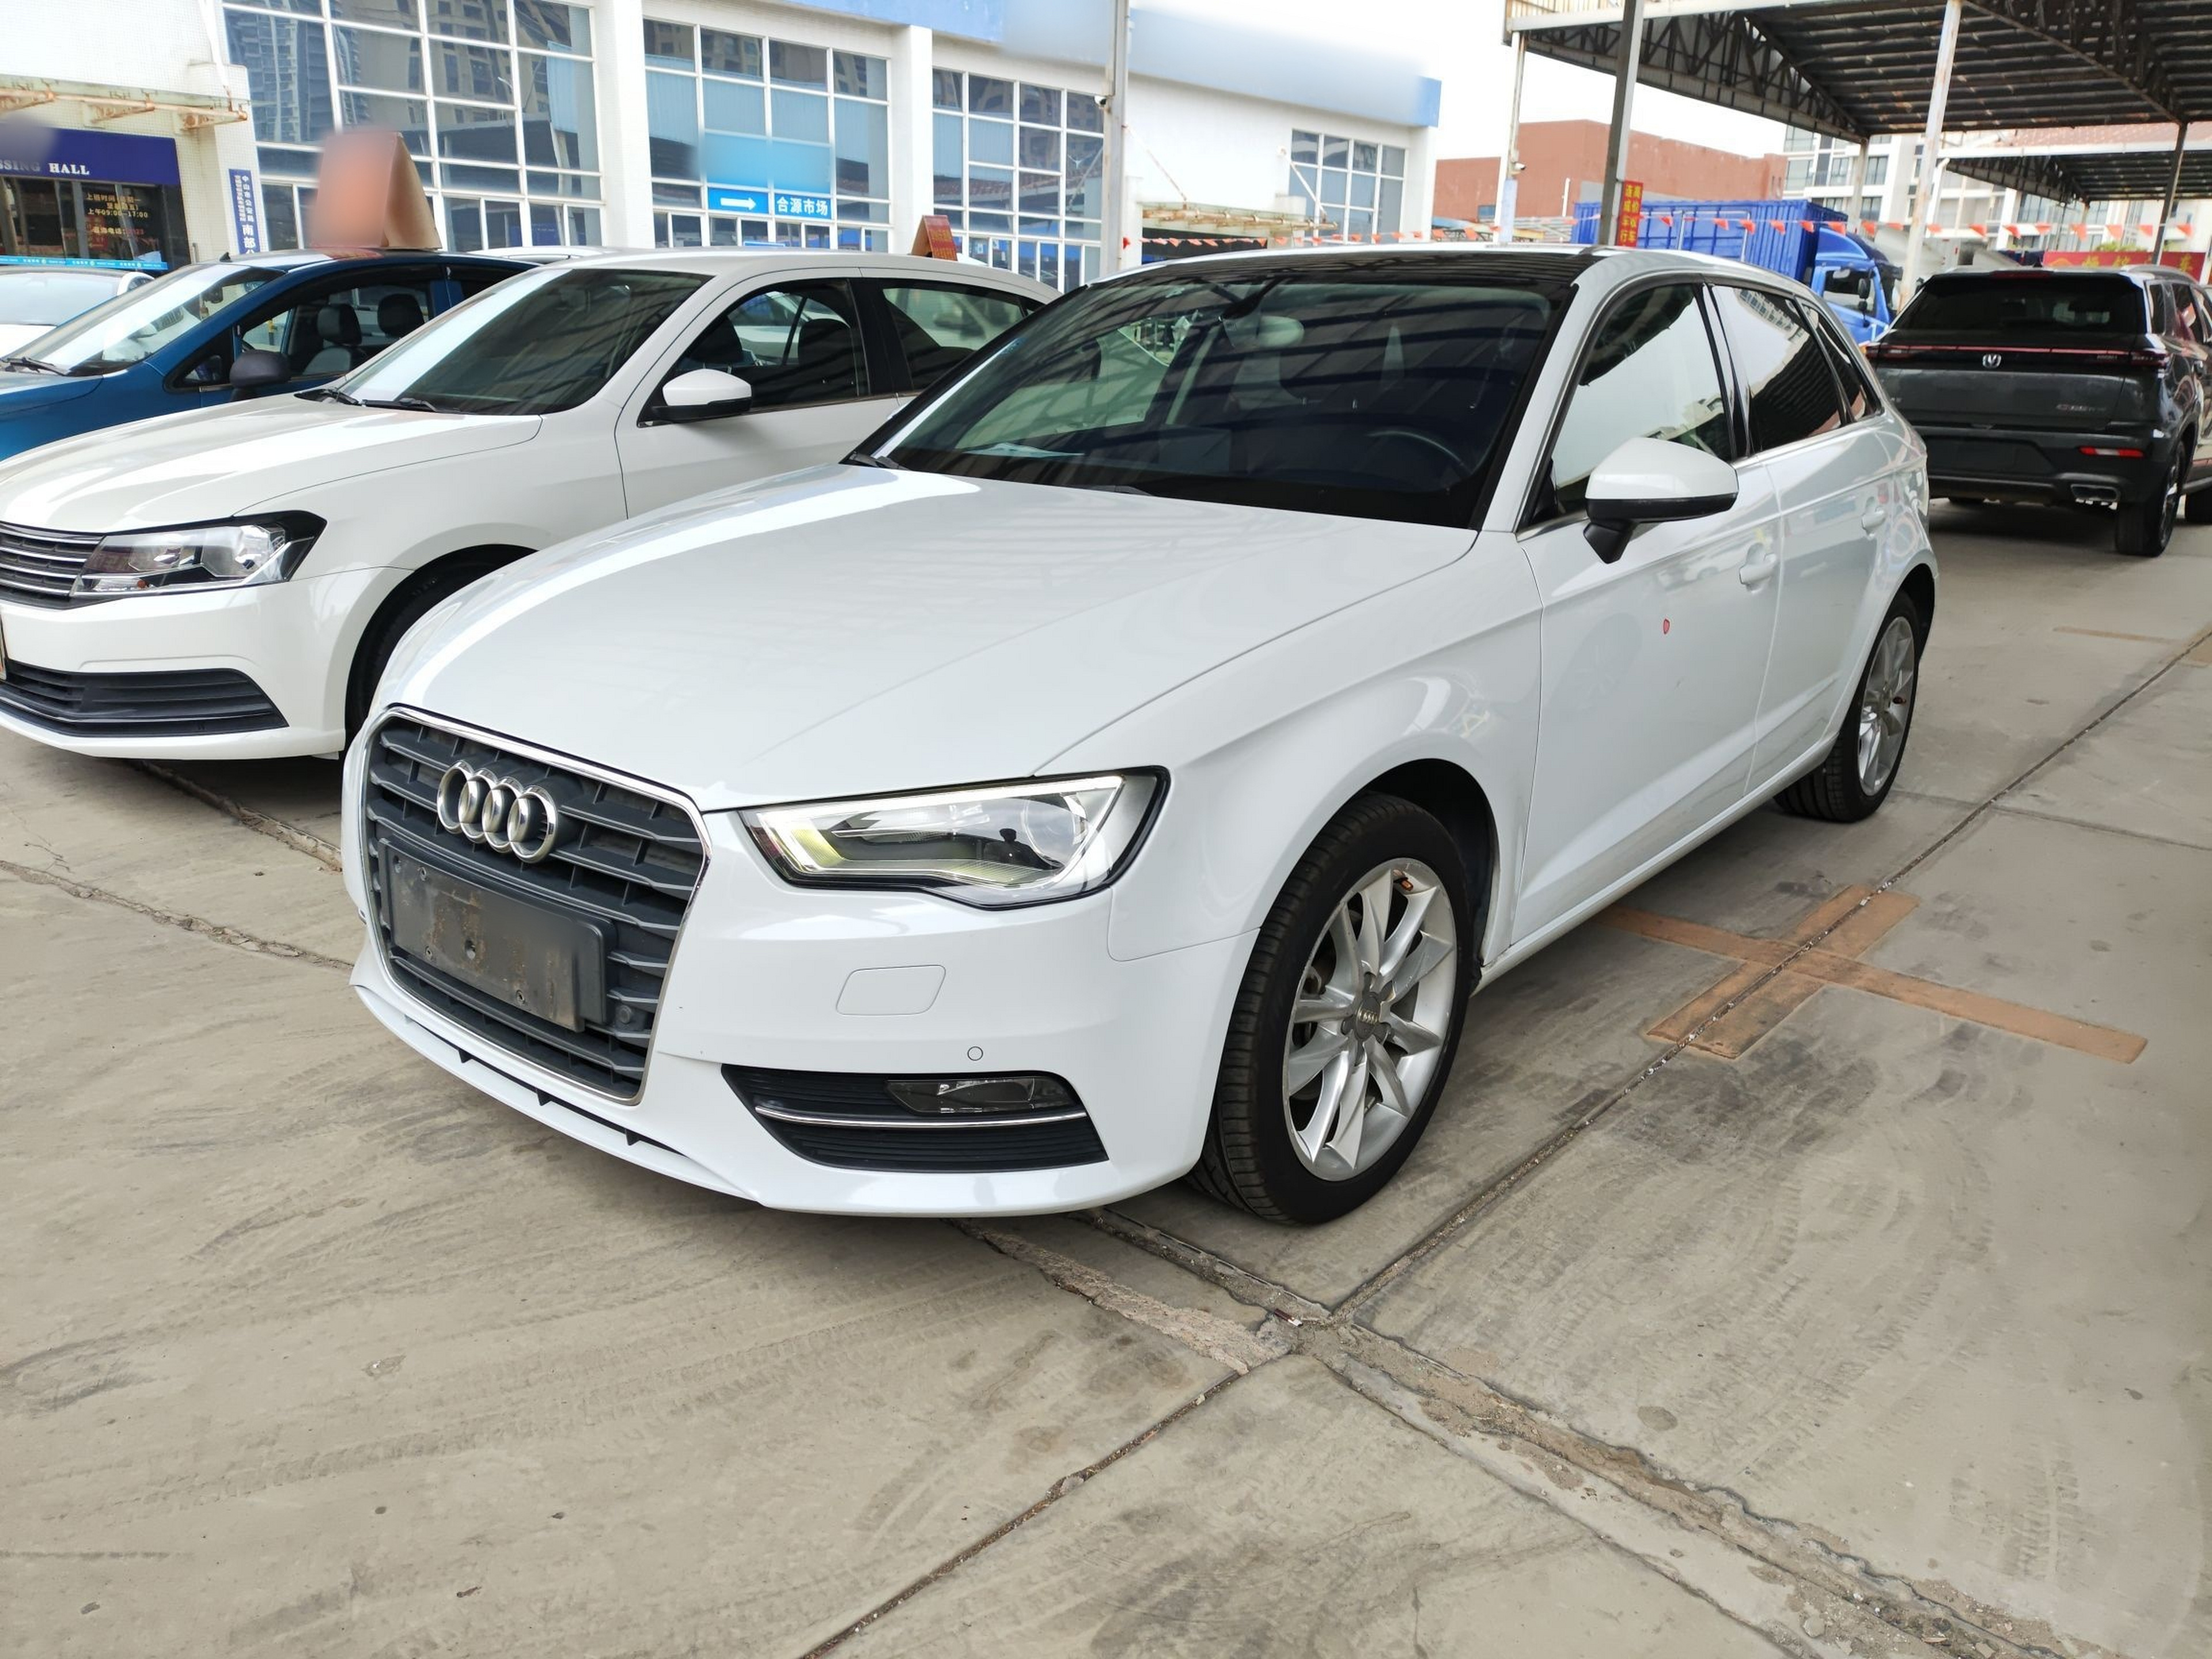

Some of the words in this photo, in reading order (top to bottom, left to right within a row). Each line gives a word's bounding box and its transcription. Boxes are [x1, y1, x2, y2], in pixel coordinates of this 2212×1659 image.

[48, 162, 90, 175] HALL
[777, 196, 828, 215] 合源市场
